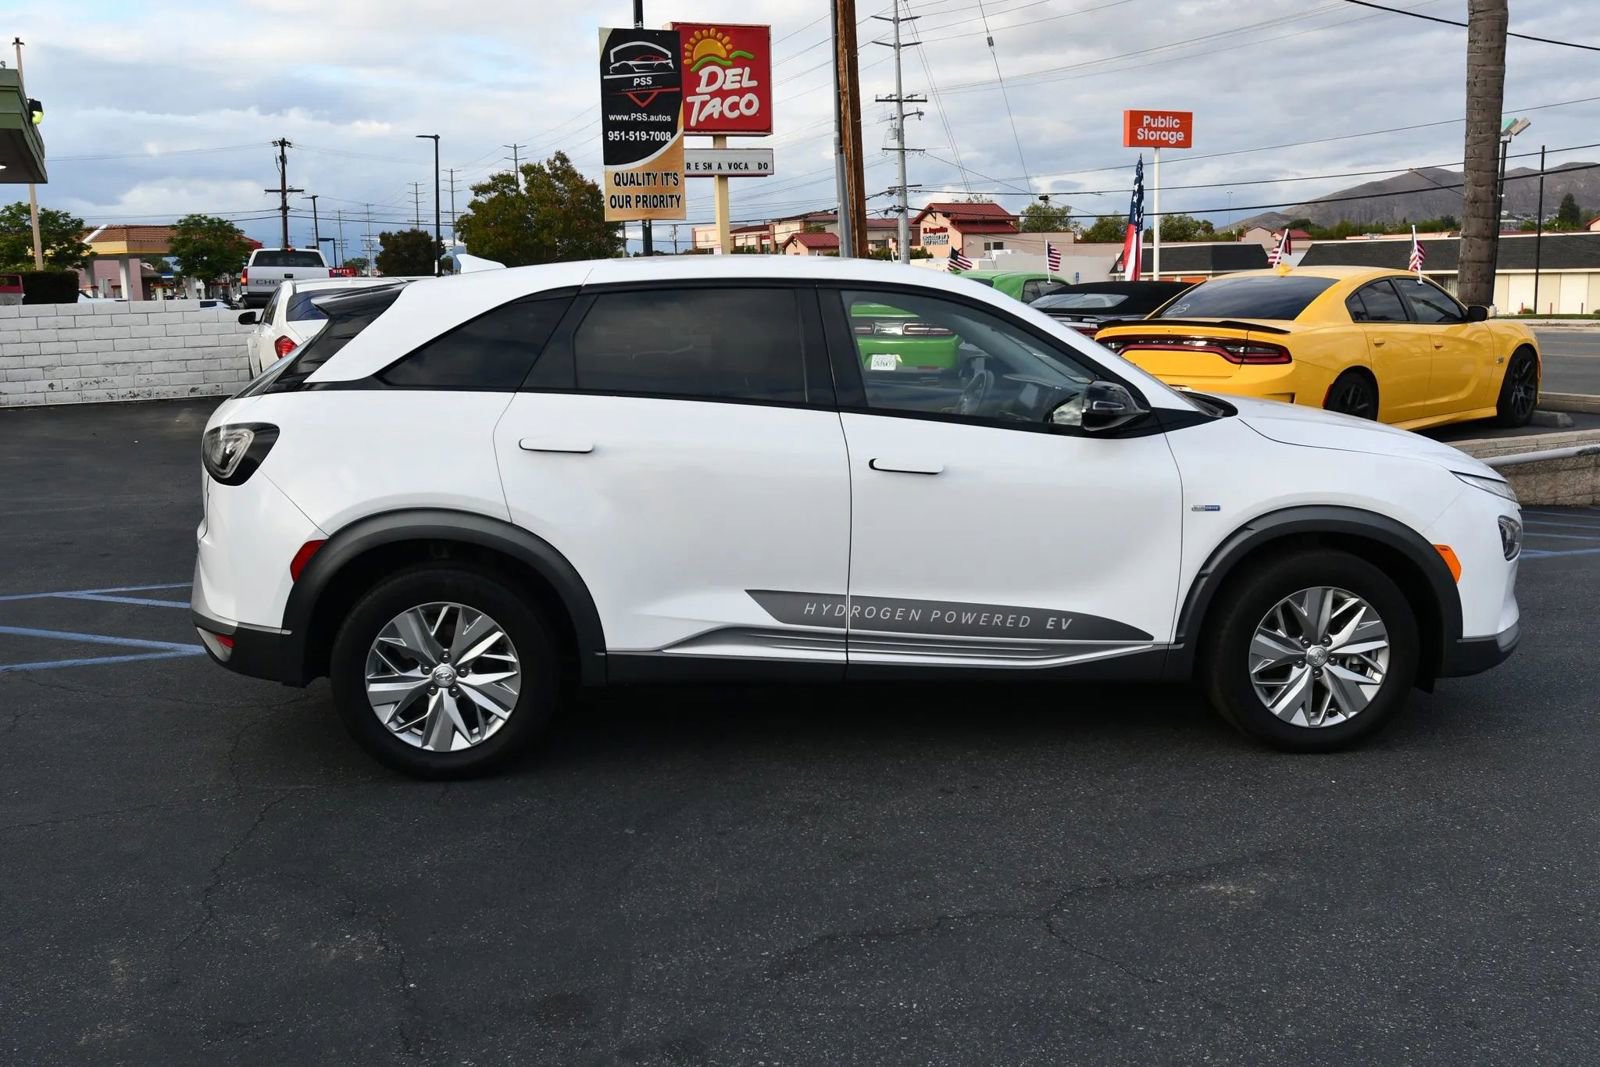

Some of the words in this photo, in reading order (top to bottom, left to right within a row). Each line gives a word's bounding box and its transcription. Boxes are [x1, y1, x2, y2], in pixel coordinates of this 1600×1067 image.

[633, 77, 652, 86] PSS
[695, 65, 758, 94] DEL
[608, 113, 671, 121] www.PSS.autos
[686, 93, 760, 127] TACO
[1143, 115, 1181, 128] Public
[608, 131, 671, 141] 951-519-7008
[1137, 127, 1184, 144] Storage
[613, 172, 658, 187] QUALITY
[661, 172, 679, 187] IT'S
[609, 194, 632, 209] OUR
[635, 193, 681, 209] PRIORITY
[803, 602, 922, 622] HYDROGEN
[930, 610, 1031, 628] POWERED
[1046, 617, 1073, 630] EV
